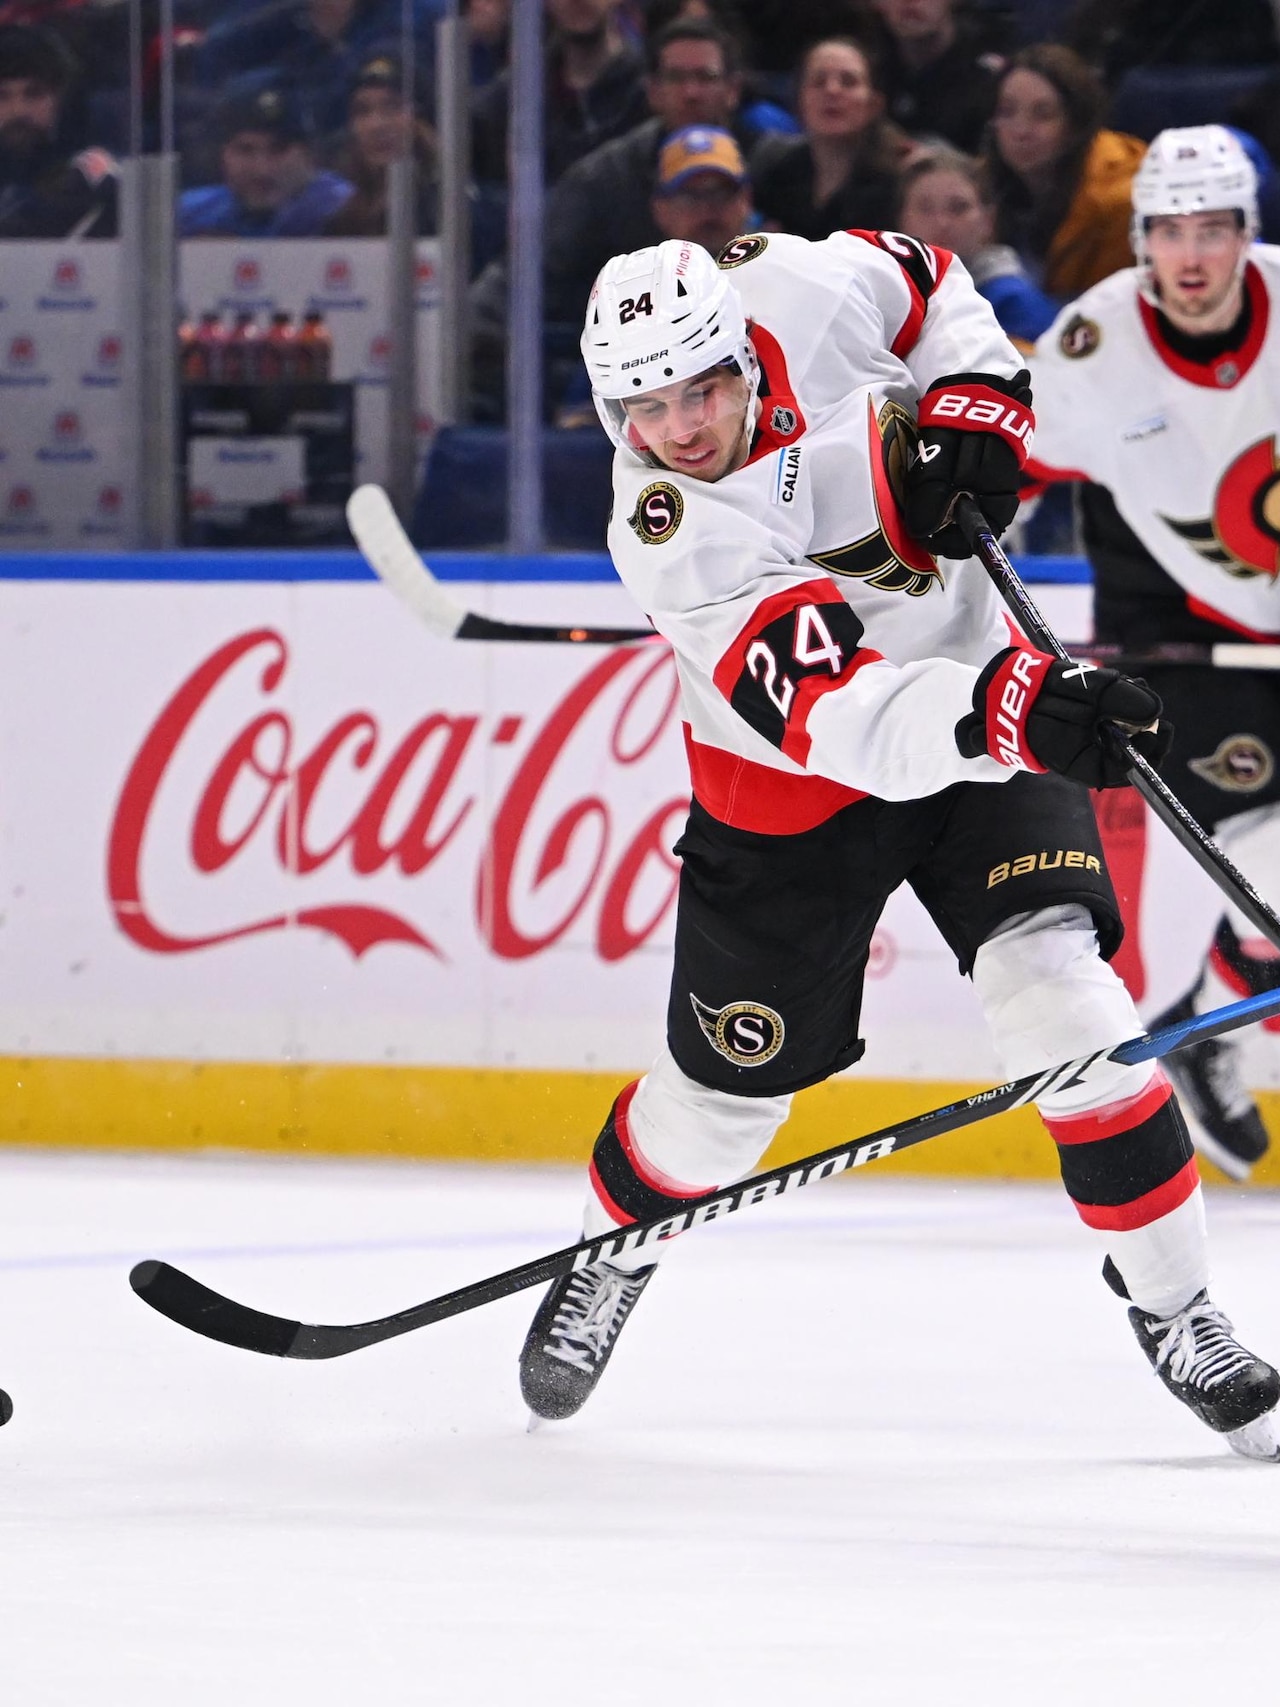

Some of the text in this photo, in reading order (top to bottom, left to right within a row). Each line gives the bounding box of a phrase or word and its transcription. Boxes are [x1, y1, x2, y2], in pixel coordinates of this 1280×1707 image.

[619, 292, 653, 325] 24
[621, 349, 669, 371] BAUER
[645, 493, 671, 533] S
[746, 603, 842, 720] 24
[987, 849, 1102, 891] BAUER
[733, 1016, 765, 1053] S
[966, 1082, 1017, 1107] ALPHA
[571, 1136, 897, 1273] WARRIOR
